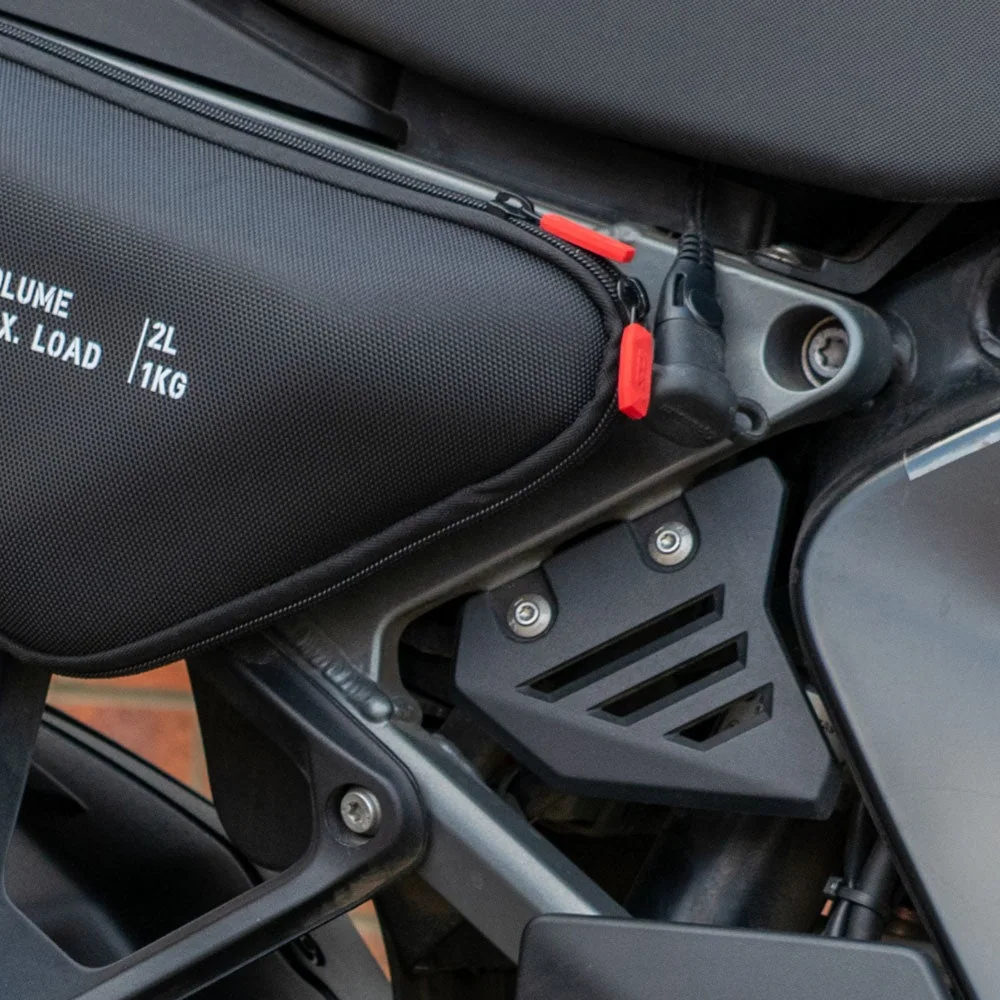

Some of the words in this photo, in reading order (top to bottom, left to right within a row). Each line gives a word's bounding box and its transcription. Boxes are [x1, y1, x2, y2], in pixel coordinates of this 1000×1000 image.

[30, 323, 102, 370] LOAD
[140, 361, 188, 400] 1KG
[146, 321, 177, 356] 2L
